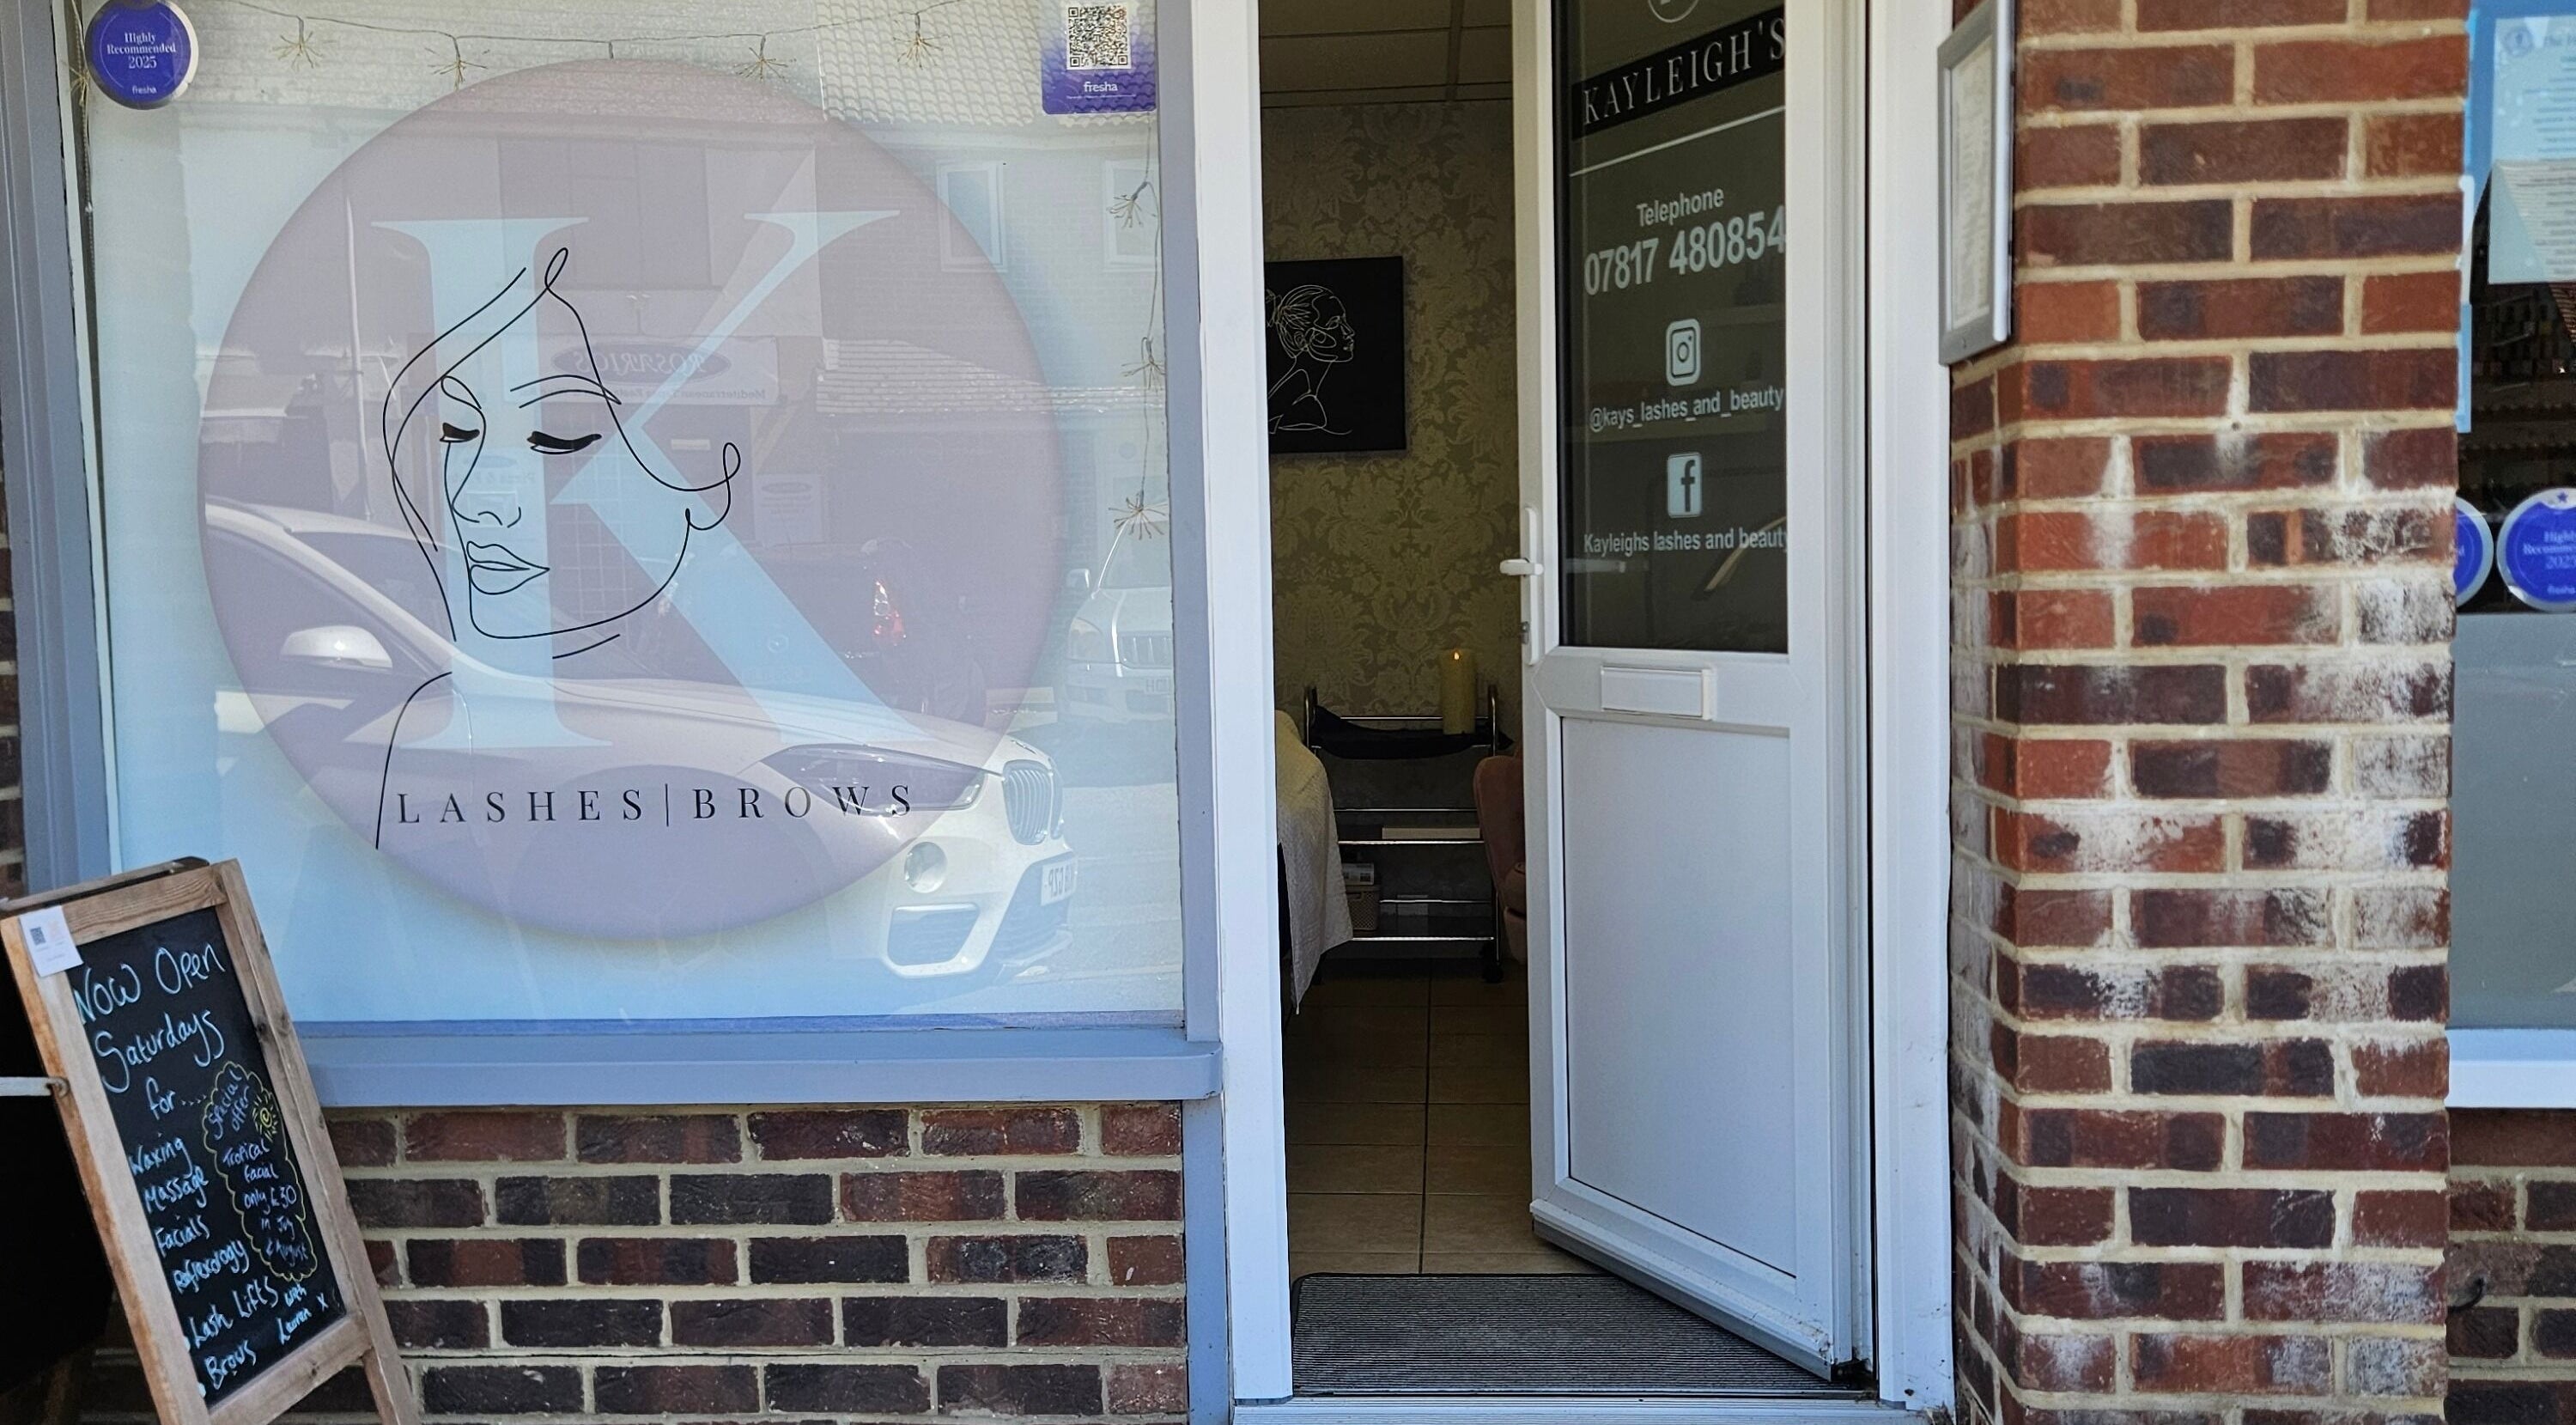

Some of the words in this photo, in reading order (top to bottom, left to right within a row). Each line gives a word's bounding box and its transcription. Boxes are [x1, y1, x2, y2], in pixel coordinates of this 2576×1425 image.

[106, 43, 177, 54] Recommended
[124, 32, 156, 45] Highly
[128, 56, 158, 69] 2025
[1583, 17, 1785, 125] KAYLEIGH'S
[132, 85, 157, 94] fresha
[1083, 82, 1118, 93] fresha
[1635, 187, 1725, 227] Telephone
[1583, 237, 1660, 296] 07817
[1668, 204, 1786, 276] 480854
[1589, 386, 1784, 433] @kays_lashes_and_beauty
[1583, 533, 1649, 557] Kayleighs
[1653, 530, 1701, 551] lashes
[1705, 527, 1734, 551] and
[94, 1009, 225, 1093] Saturdays
[129, 1132, 193, 1178] Waxing
[144, 1166, 210, 1215] Massage
[244, 1189, 271, 1215] only
[155, 1215, 210, 1258] Facials
[188, 1304, 234, 1349] Lash
[204, 1339, 257, 1391] Brows
